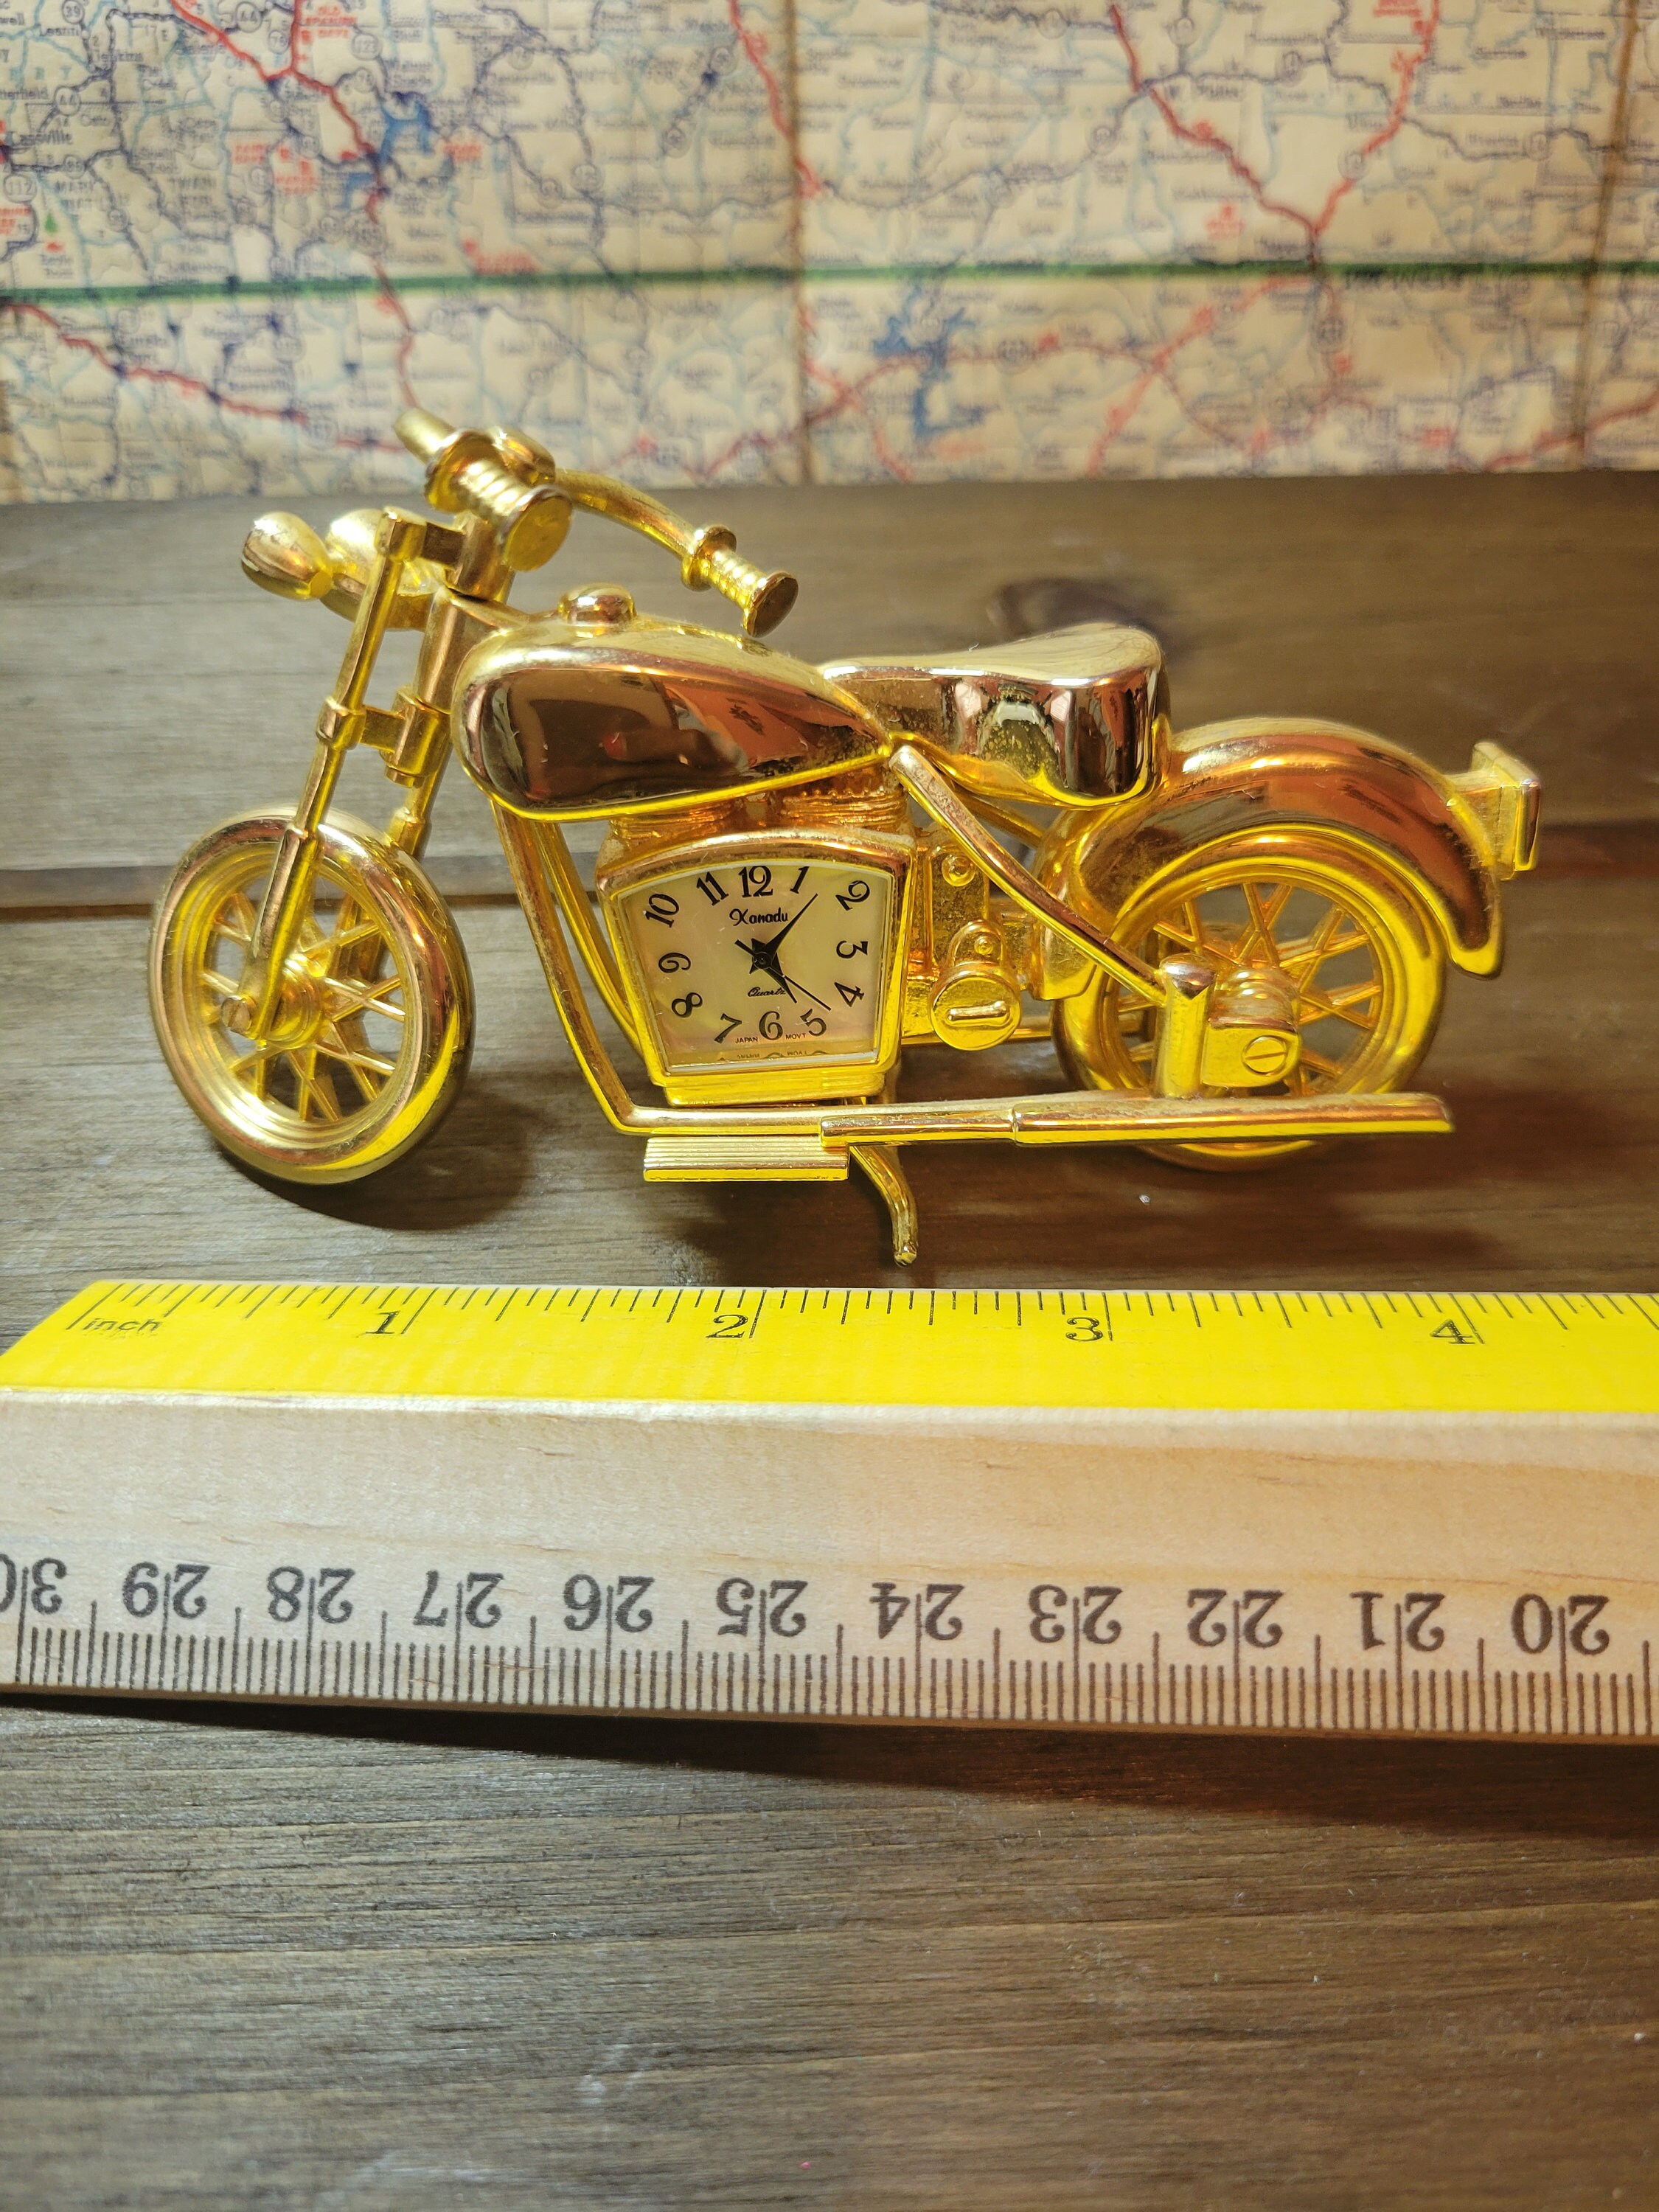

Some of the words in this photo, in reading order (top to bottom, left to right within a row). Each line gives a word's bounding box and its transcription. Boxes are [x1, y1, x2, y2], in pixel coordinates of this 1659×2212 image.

[696, 872, 728, 906] 11
[738, 865, 773, 898] 12
[789, 866, 810, 894] 1
[835, 880, 871, 911] 2
[645, 893, 680, 928] 10
[728, 907, 789, 927] Xanadu
[658, 952, 692, 974] 9
[835, 940, 869, 959] 3
[671, 992, 703, 1018] 8
[747, 986, 787, 998] Quartz
[834, 981, 865, 1008] 4
[714, 1012, 743, 1044] 7
[758, 1011, 784, 1041] 6
[800, 1008, 827, 1037] 5
[735, 1036, 759, 1044] JAPAN
[83, 1317, 163, 1332] inch
[365, 1310, 402, 1335] 1
[706, 1313, 749, 1340] 2
[1065, 1316, 1105, 1343] 3
[1430, 1318, 1476, 1346] 4
[122, 1561, 210, 1619] 29
[265, 1565, 356, 1624] 28
[413, 1569, 504, 1629] 27
[563, 1573, 655, 1633] 26
[716, 1577, 809, 1638] 25
[869, 1581, 965, 1641] 24
[1029, 1584, 1123, 1645] 23
[1186, 1587, 1285, 1649] 22
[1349, 1590, 1446, 1652] 21
[1511, 1593, 1610, 1655] 20
